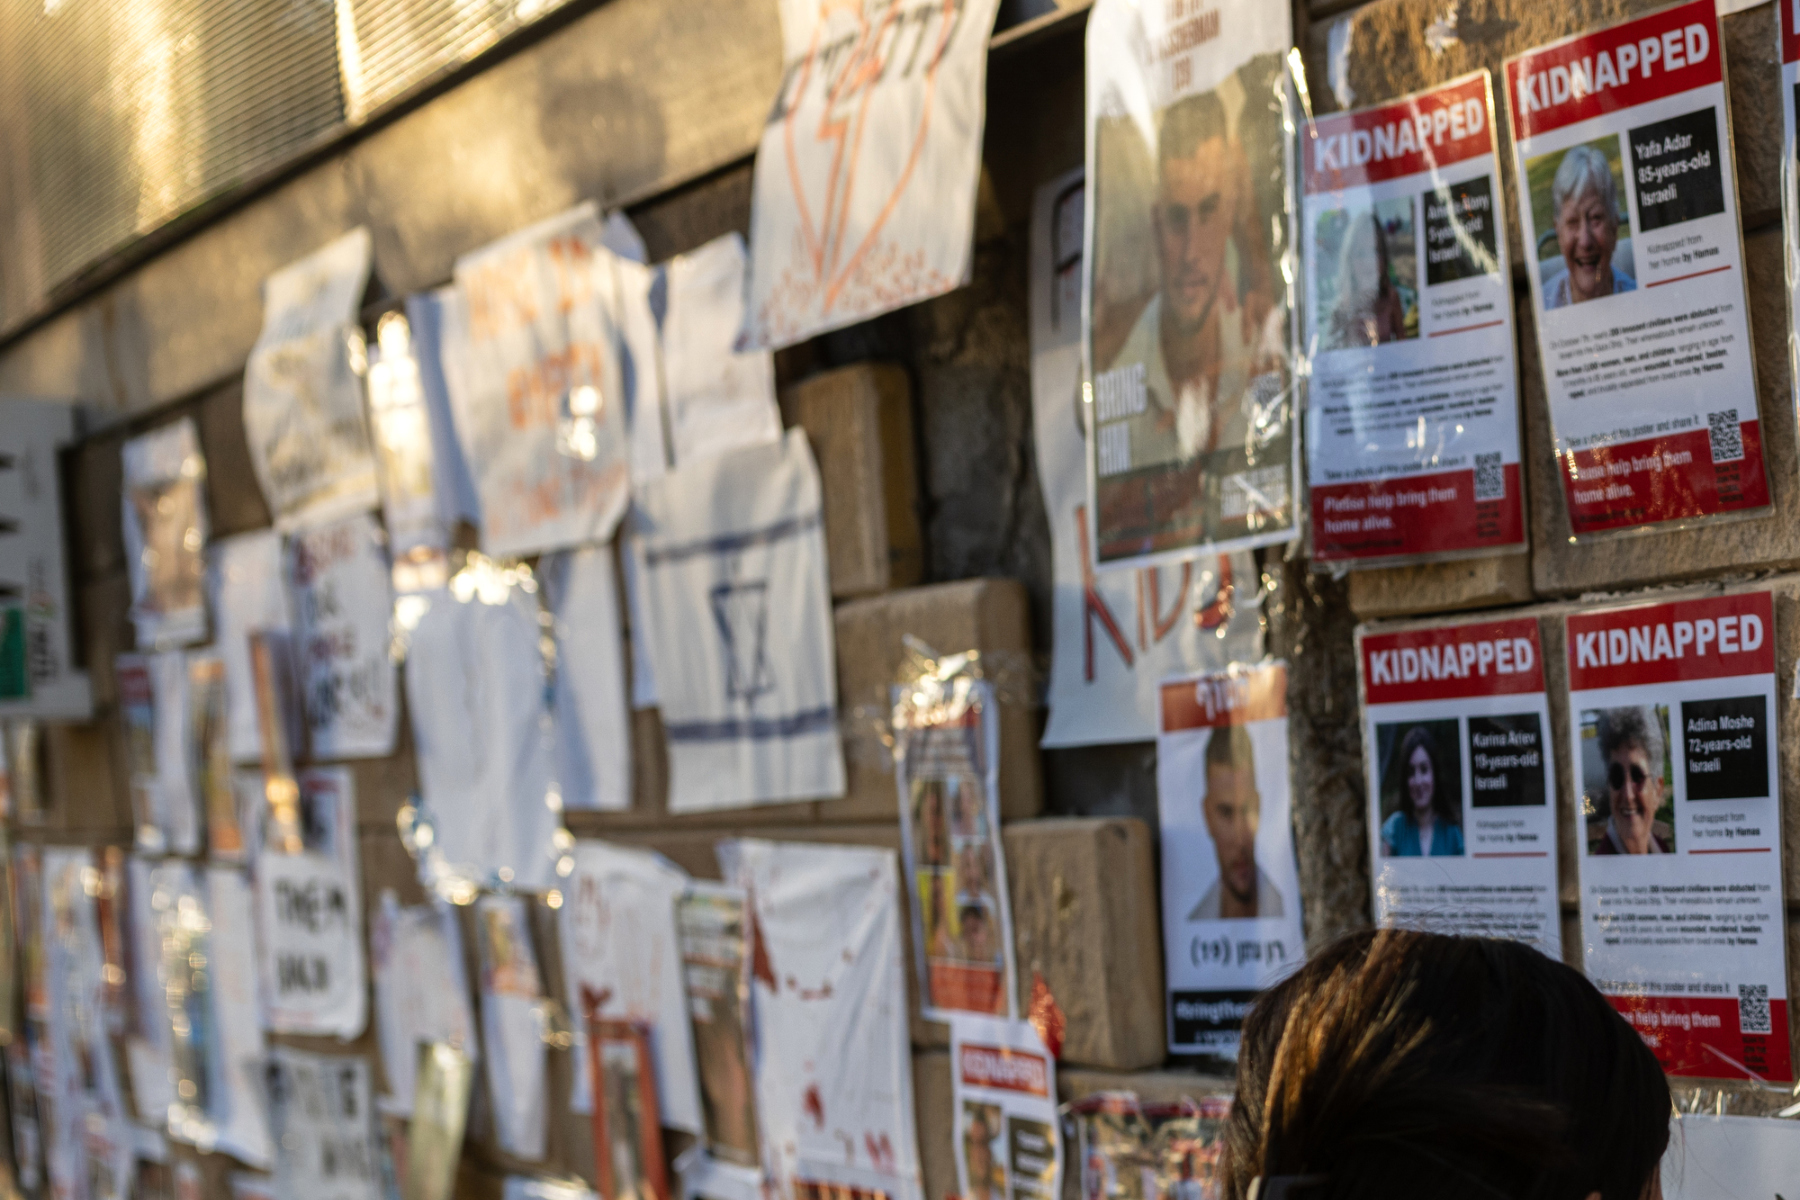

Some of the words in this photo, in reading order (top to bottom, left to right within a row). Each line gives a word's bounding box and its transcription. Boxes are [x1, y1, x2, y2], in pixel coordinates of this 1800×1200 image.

[1517, 24, 1711, 116] KIDNAPPED
[1313, 100, 1485, 170] KIDNAPPED
[1371, 638, 1534, 684] KIDNAPPED
[1576, 614, 1763, 668] KIDNAPPED
